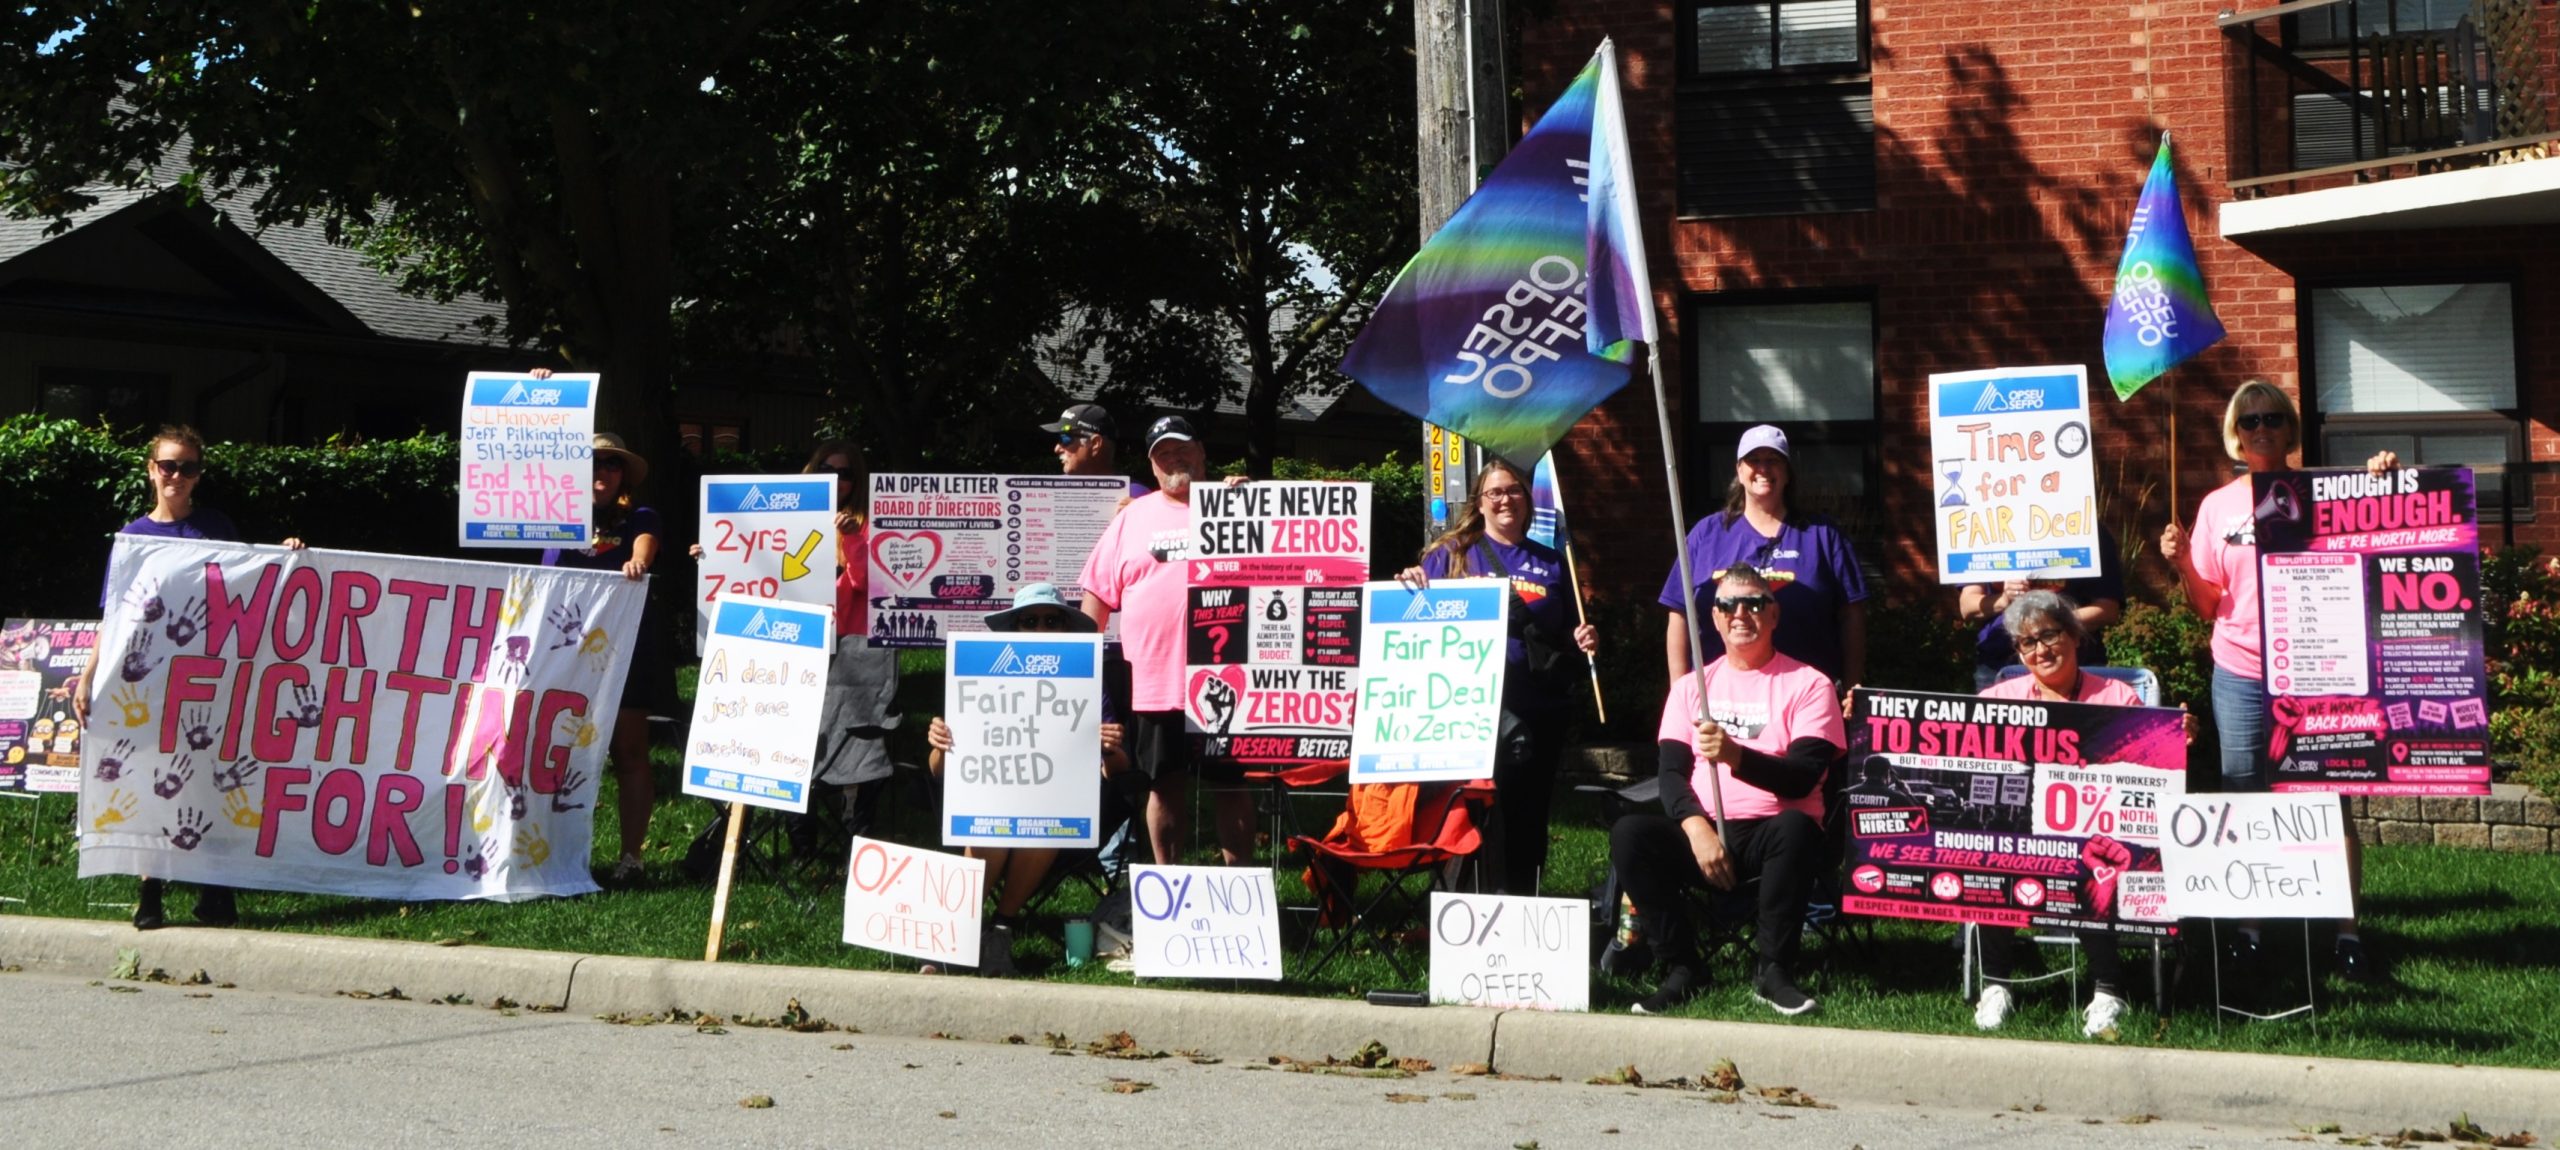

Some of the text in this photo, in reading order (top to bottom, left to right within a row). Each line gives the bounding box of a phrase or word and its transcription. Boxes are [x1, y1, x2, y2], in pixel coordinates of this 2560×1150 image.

[2116, 274, 2162, 346] SEFPO
[2132, 261, 2179, 339] OPSEU
[530, 397, 559, 405] SEFPO
[531, 389, 561, 397] OPSEU
[2009, 389, 2044, 401] OPSEU
[2009, 400, 2044, 410] SEFPO
[466, 426, 584, 446] Jeff Pilkington
[1957, 422, 2045, 462] Time
[477, 443, 594, 461] 519-364-6100
[466, 463, 575, 490] End the
[875, 476, 998, 494] AN OPEN LETTER
[1976, 471, 2060, 502] for a
[2312, 468, 2419, 501] ENOUGH IS
[474, 490, 584, 523] STRIKE
[769, 502, 800, 510] SEFPO
[770, 493, 800, 501] OPSEU
[874, 500, 1001, 516] BOARD OF DIRECTORS
[1199, 486, 1357, 518] WE'VE NEVER
[882, 520, 994, 528] HANOVER COMMUNITY LIVING
[1949, 496, 2091, 549] FAIR Deal
[2313, 490, 2462, 534] ENOUGH.
[1200, 518, 1364, 555] SEEN ZEROS.
[2327, 528, 2460, 550] WE'RE WORTH MORE.
[1214, 561, 1240, 572] NEVER
[1262, 564, 1284, 572] history
[2380, 557, 2454, 572] WE SAID
[704, 574, 778, 602] Zero
[1257, 574, 1273, 582] have
[1306, 570, 1324, 584] 0%
[1202, 590, 1232, 607] WHY
[2382, 572, 2472, 611] NO.
[1194, 604, 1245, 620] THIS YEAR?
[1435, 610, 1467, 620] SEFPO
[1436, 600, 1468, 610] OPSEU
[204, 562, 504, 683] WORTH
[772, 620, 801, 633] OPSEU
[51, 632, 74, 647] THE
[770, 630, 800, 642] SEFPO
[1256, 632, 1294, 640] ALWAYS BEEN
[1025, 655, 1060, 665] OPSEU
[1259, 650, 1292, 660] BUDGET.
[1383, 625, 1494, 674] Fair Pay
[704, 648, 728, 684] A
[742, 659, 789, 685] deal
[1025, 665, 1059, 674] SEFPO
[1252, 669, 1346, 690] WHY THE
[1364, 672, 1496, 710] Fair Deal
[703, 696, 790, 724] just one
[958, 680, 1088, 732] Fair Pay
[1246, 692, 1356, 725] ZEROS?
[1868, 696, 2048, 728] THEY CAN AFFORD
[159, 654, 588, 794] FIGHTING
[983, 714, 1040, 748] isn't
[1205, 738, 1350, 758] WE DESERVE BETTER.
[1866, 717, 1911, 754] TO
[1919, 720, 2026, 762] STALK
[960, 752, 1054, 785] GREED
[1900, 756, 1917, 764] BUT
[1920, 758, 1938, 767] NOT
[1942, 759, 1953, 768] TO
[1957, 760, 1998, 772] RESPECT
[2048, 770, 2168, 788] THE OFFER TO WORKERS?
[1850, 794, 1890, 806] SECURITY
[2045, 782, 2114, 834] 0%
[255, 766, 466, 875] FOR!
[1860, 818, 1910, 834] HIRED.
[2171, 802, 2336, 848] 0% is NOT
[1934, 831, 2082, 859] ENOUGH IS ENOUGH.
[1869, 842, 2080, 875] WE SEE THEIR PRIORITIES.
[852, 843, 984, 920] 0% NOT
[2186, 875, 2218, 892] an
[1134, 870, 1266, 920] 0% NOT
[894, 901, 912, 914] an
[865, 912, 957, 954] OFFER!
[1192, 914, 1211, 932] an
[1437, 899, 1578, 952] 0% NOT
[1164, 926, 1269, 968] OFFER!
[1486, 953, 1508, 968] an
[1461, 972, 1552, 1002] OFFER
